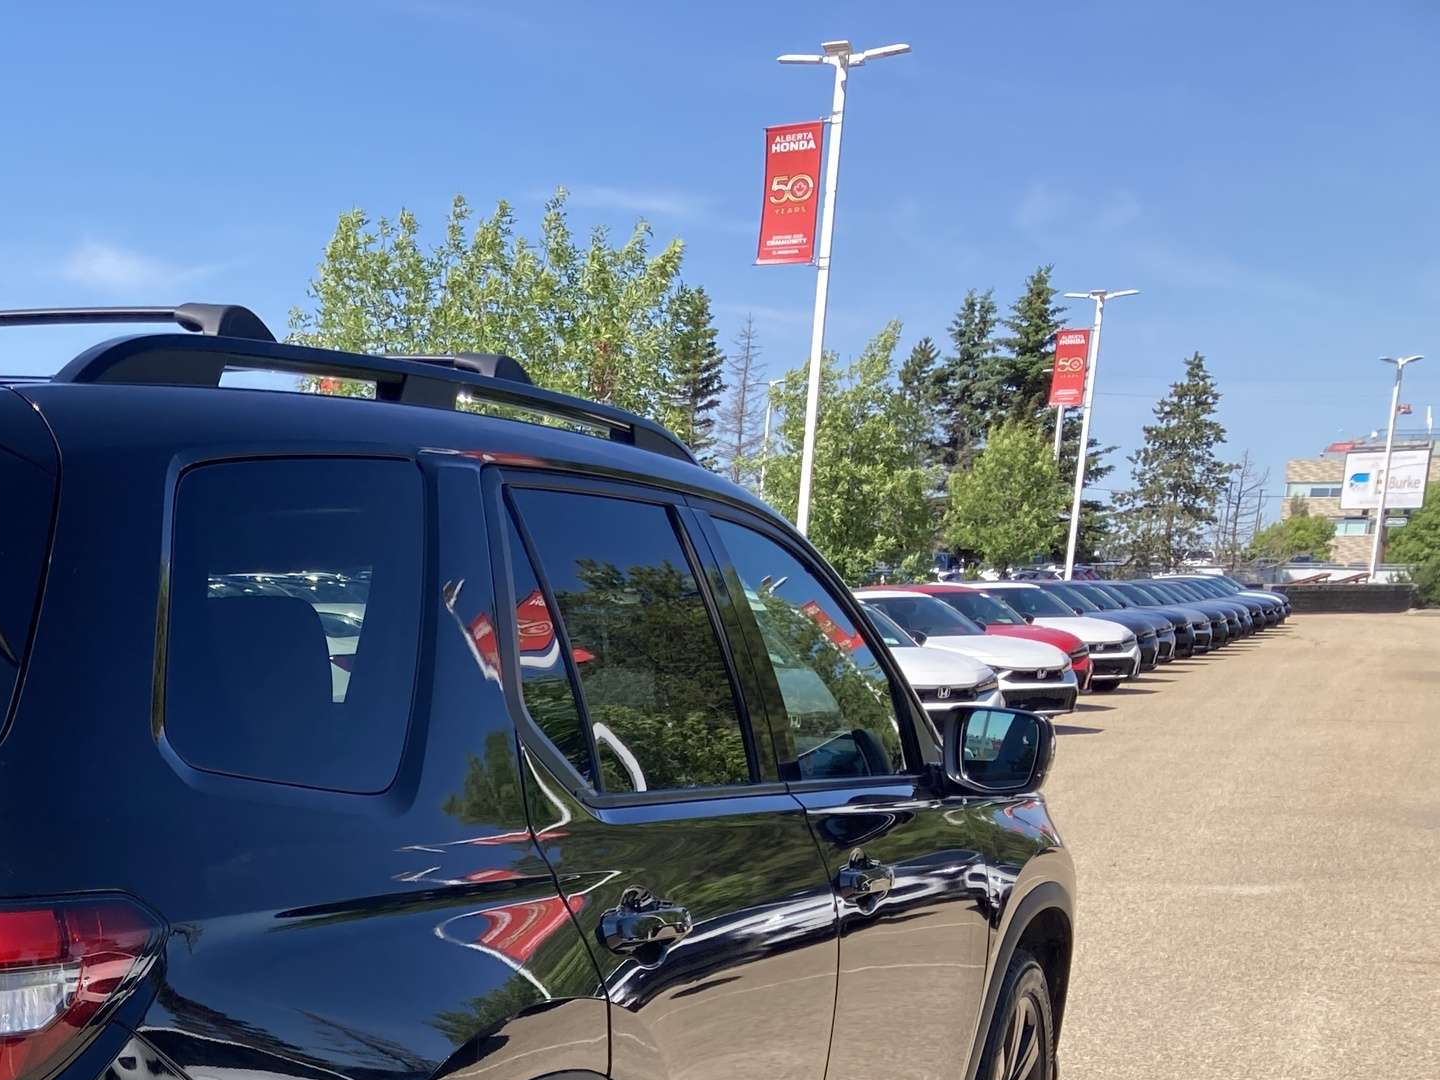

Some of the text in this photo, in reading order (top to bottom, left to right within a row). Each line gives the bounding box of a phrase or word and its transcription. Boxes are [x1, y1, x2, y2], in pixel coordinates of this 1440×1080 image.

[775, 132, 813, 143] ALBERTA
[771, 140, 816, 153] HONDA
[769, 174, 814, 204] 50
[1058, 357, 1083, 372] 50
